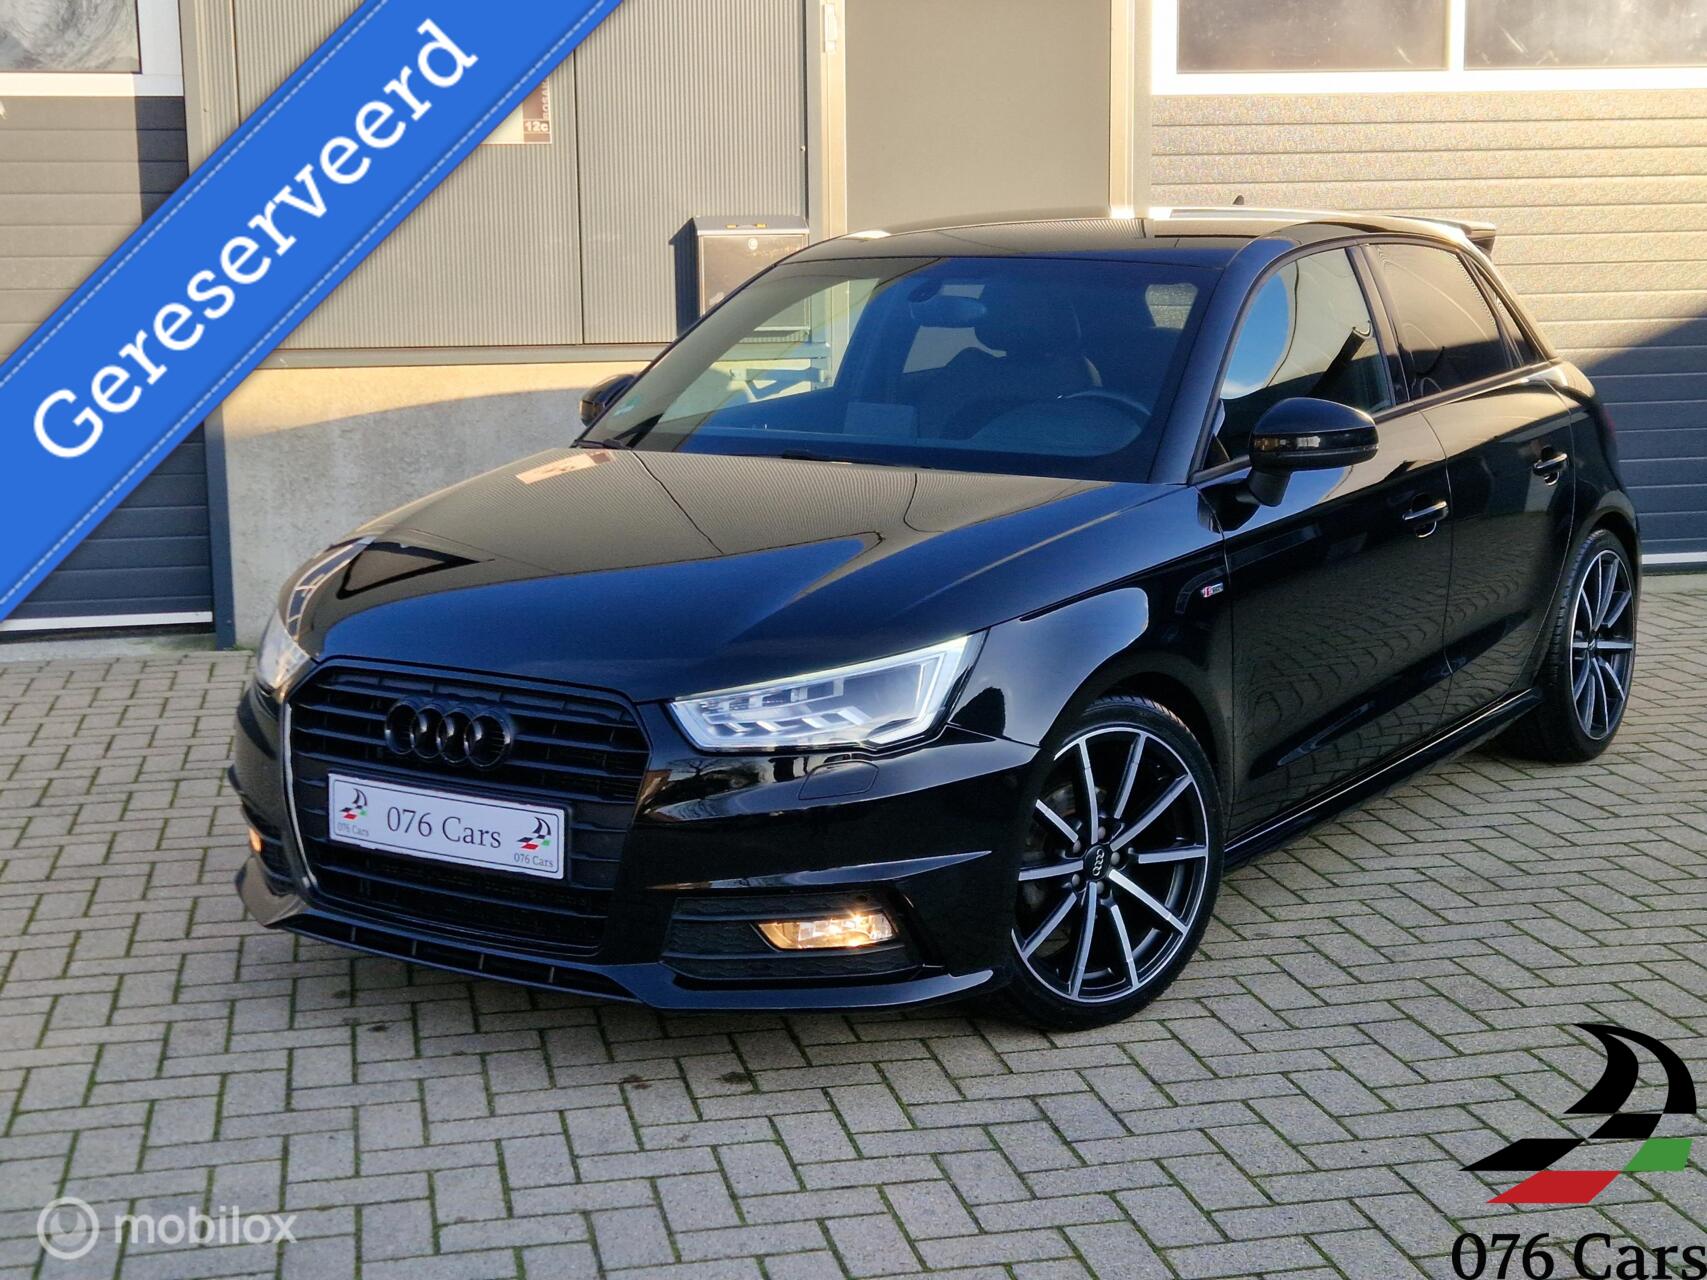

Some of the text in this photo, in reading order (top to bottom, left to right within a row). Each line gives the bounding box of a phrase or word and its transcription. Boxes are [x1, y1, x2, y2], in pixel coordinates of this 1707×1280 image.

[387, 806, 501, 848] 076 Cars
[513, 852, 554, 868] 076 Cars
